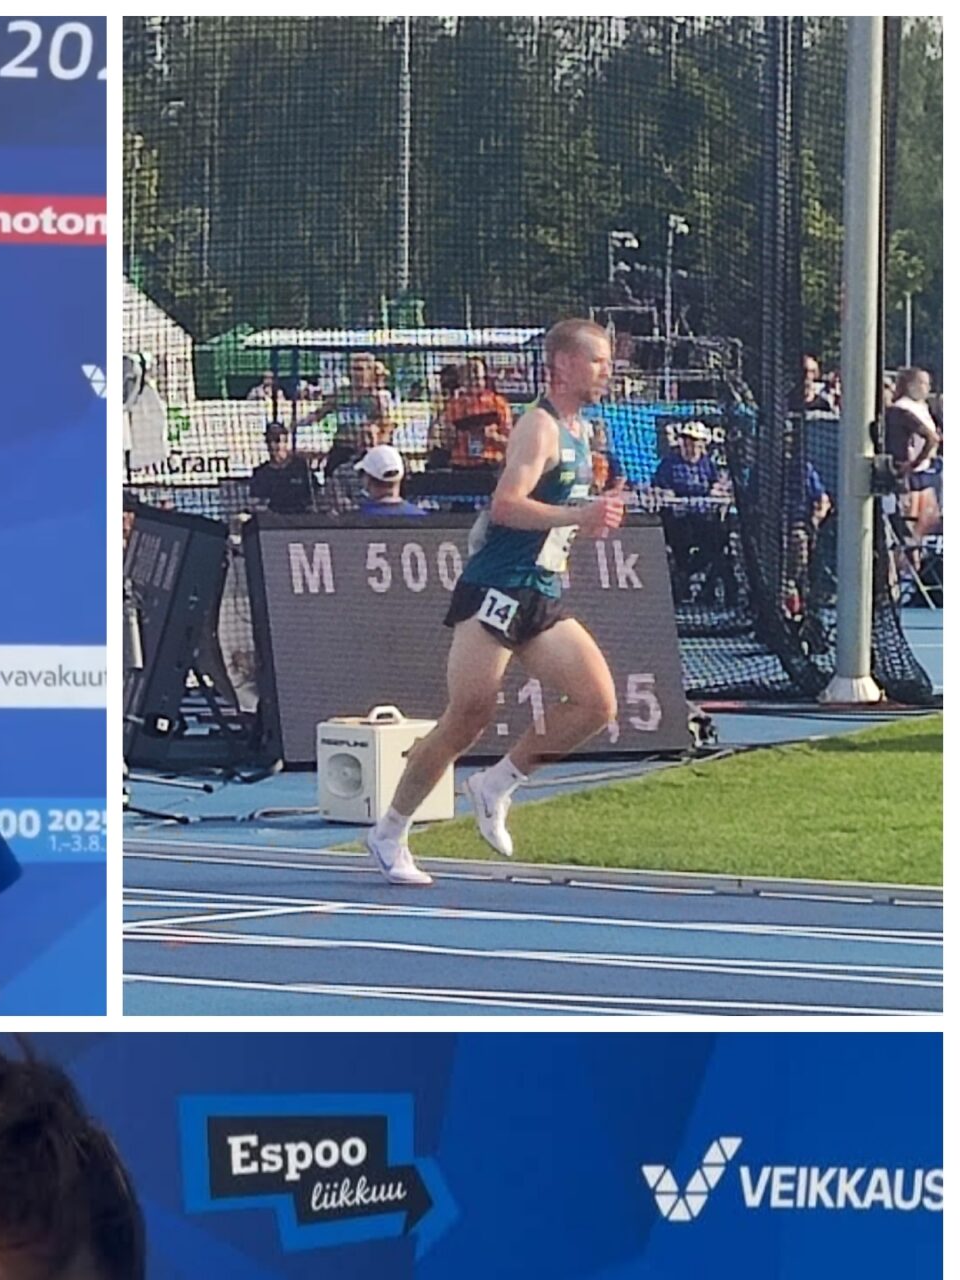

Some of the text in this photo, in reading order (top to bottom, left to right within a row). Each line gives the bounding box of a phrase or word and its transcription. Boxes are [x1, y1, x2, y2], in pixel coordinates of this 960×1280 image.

[287, 542, 336, 595] M
[489, 590, 514, 625] 14
[47, 809, 107, 837] 202
[227, 1133, 368, 1182] Espoo
[311, 1175, 408, 1212] liikkuu
[740, 1166, 943, 1212] VEIKKAUS
